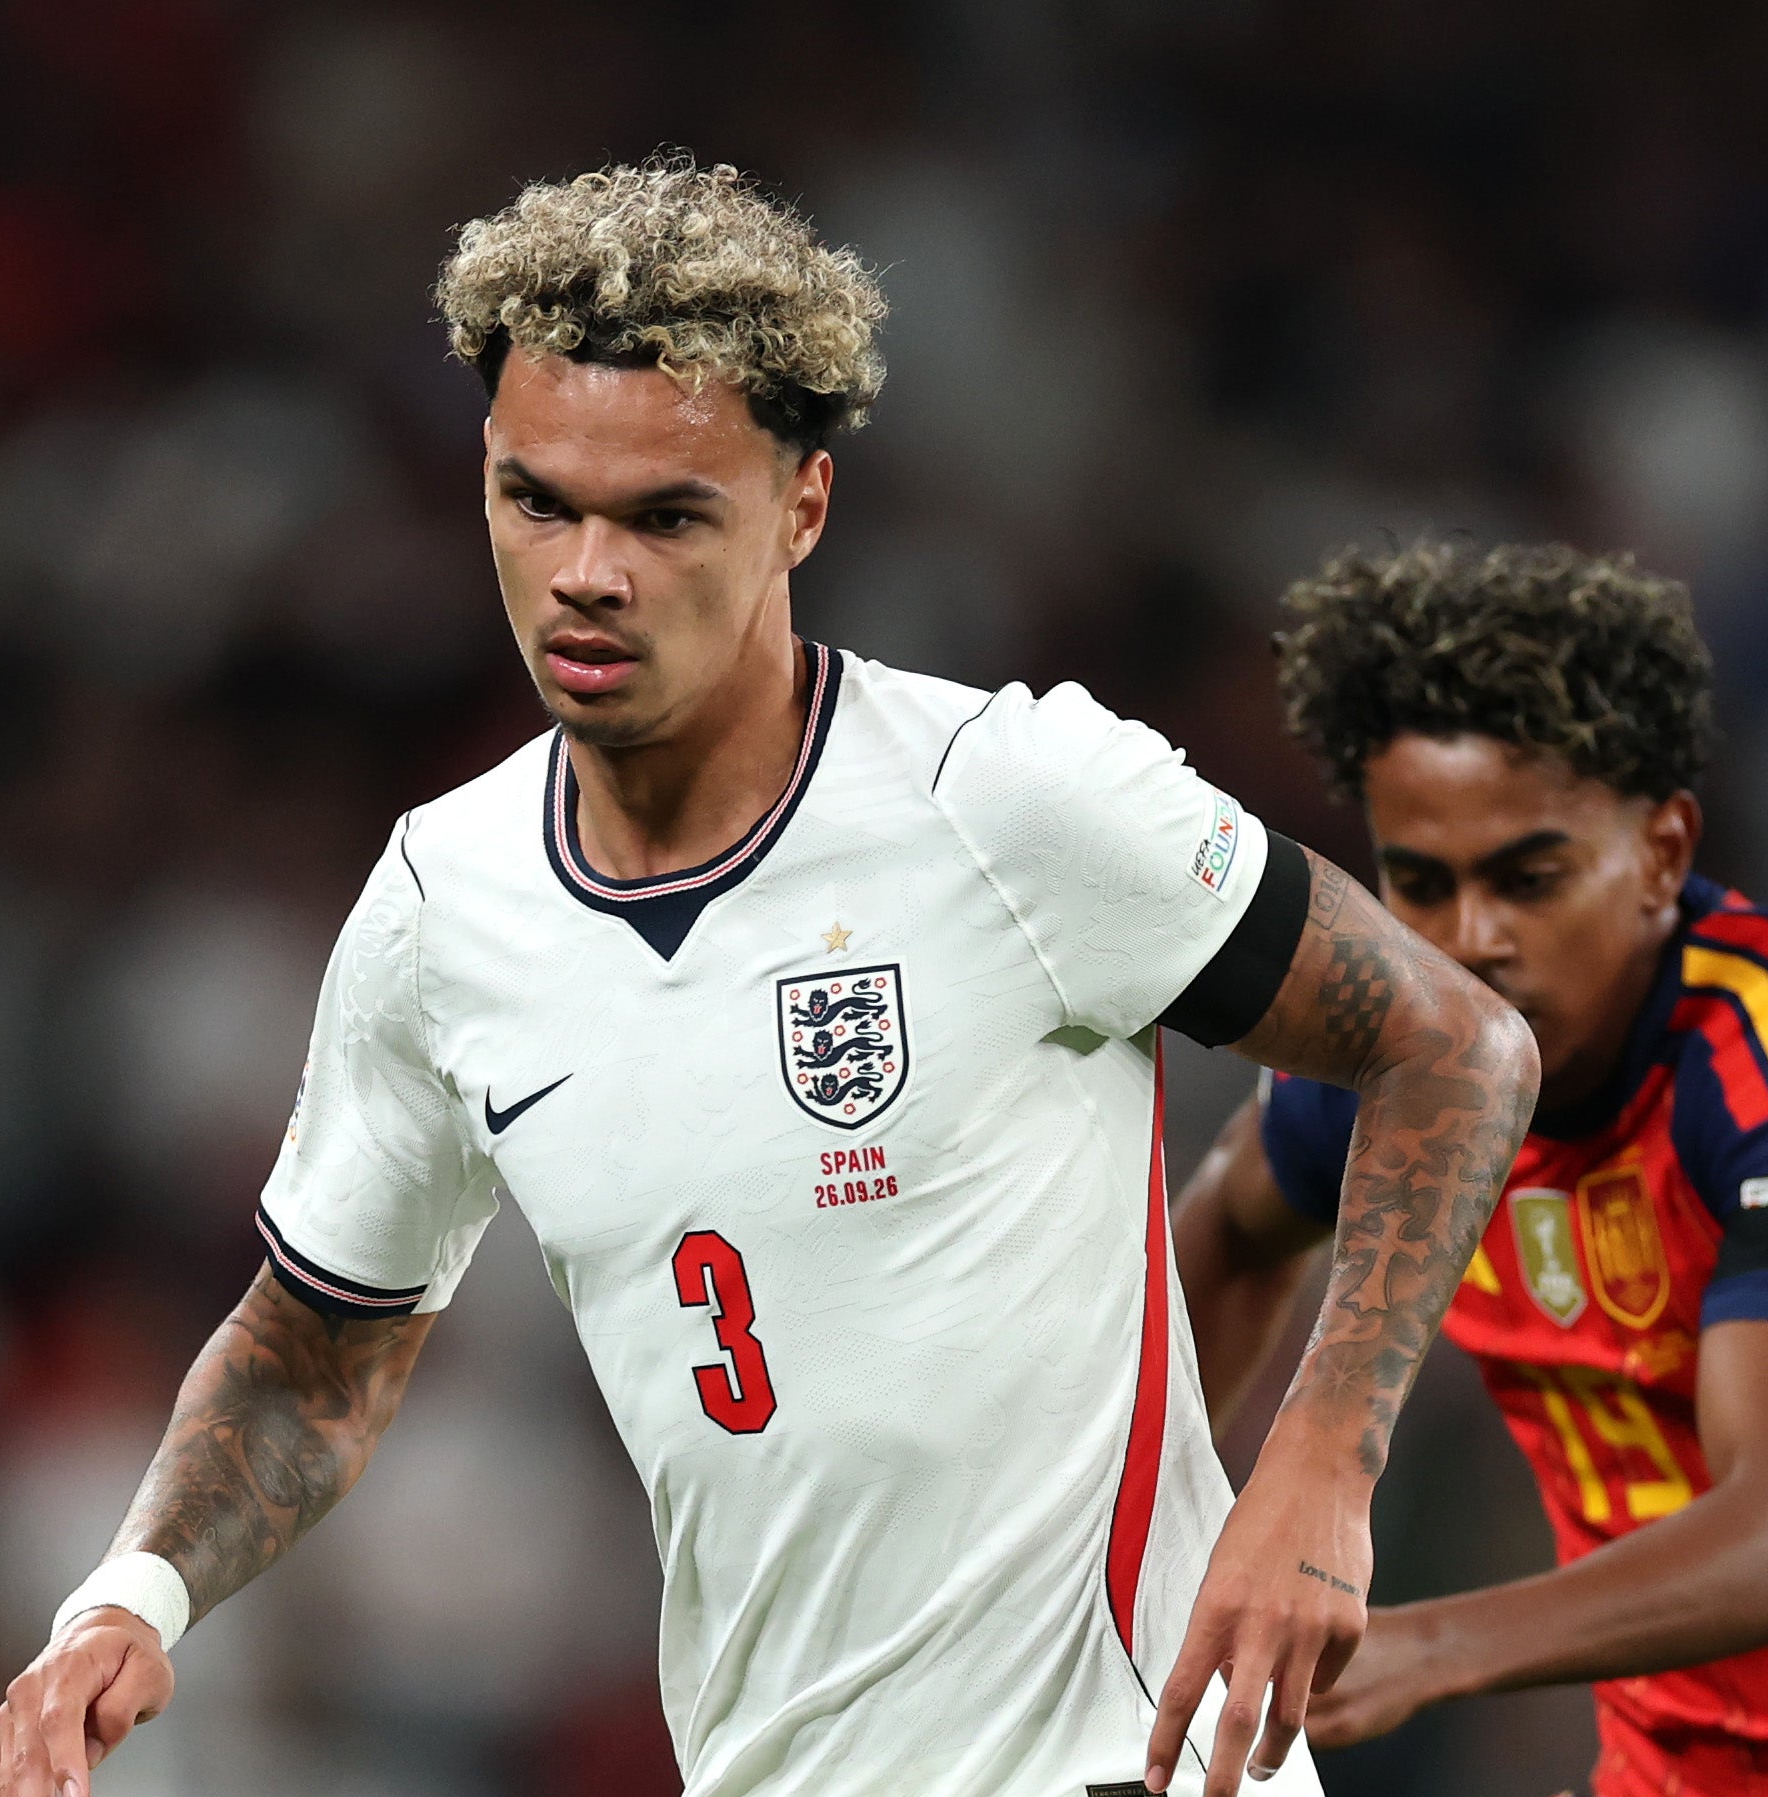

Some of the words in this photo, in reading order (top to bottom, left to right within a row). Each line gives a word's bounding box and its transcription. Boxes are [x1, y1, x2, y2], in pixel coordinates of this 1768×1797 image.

[1191, 839, 1211, 876] UEFA
[820, 1146, 885, 1175] SPAIN
[814, 1175, 898, 1208] 26.09.26
[672, 1230, 777, 1435] 3
[1517, 1362, 1694, 1523] 19
